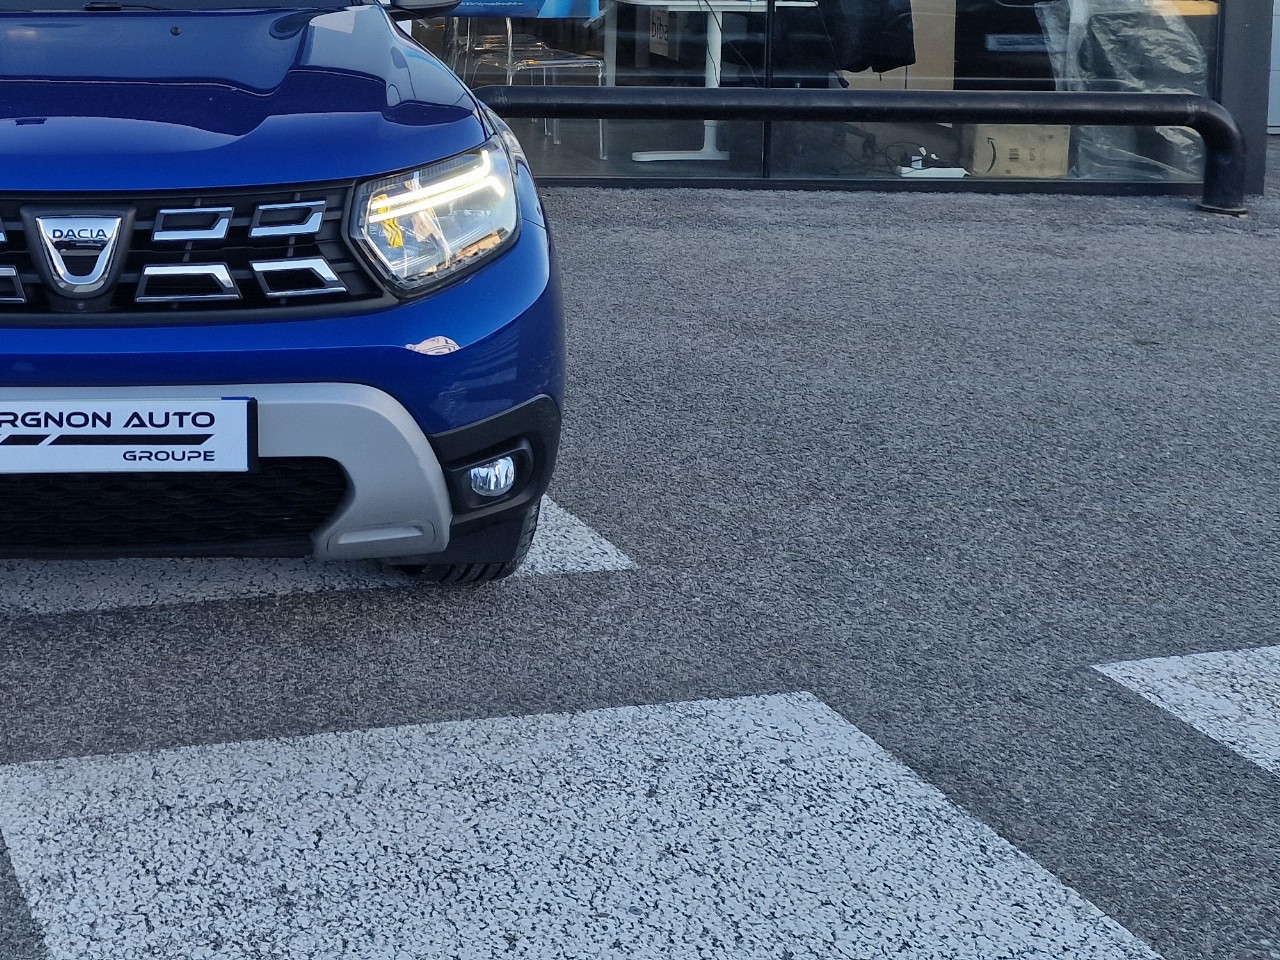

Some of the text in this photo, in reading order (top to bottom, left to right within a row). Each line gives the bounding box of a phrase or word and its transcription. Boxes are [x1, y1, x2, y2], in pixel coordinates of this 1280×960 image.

[52, 229, 107, 239] DACIA
[122, 411, 216, 428] AUTO
[122, 450, 216, 462] GROUPE
